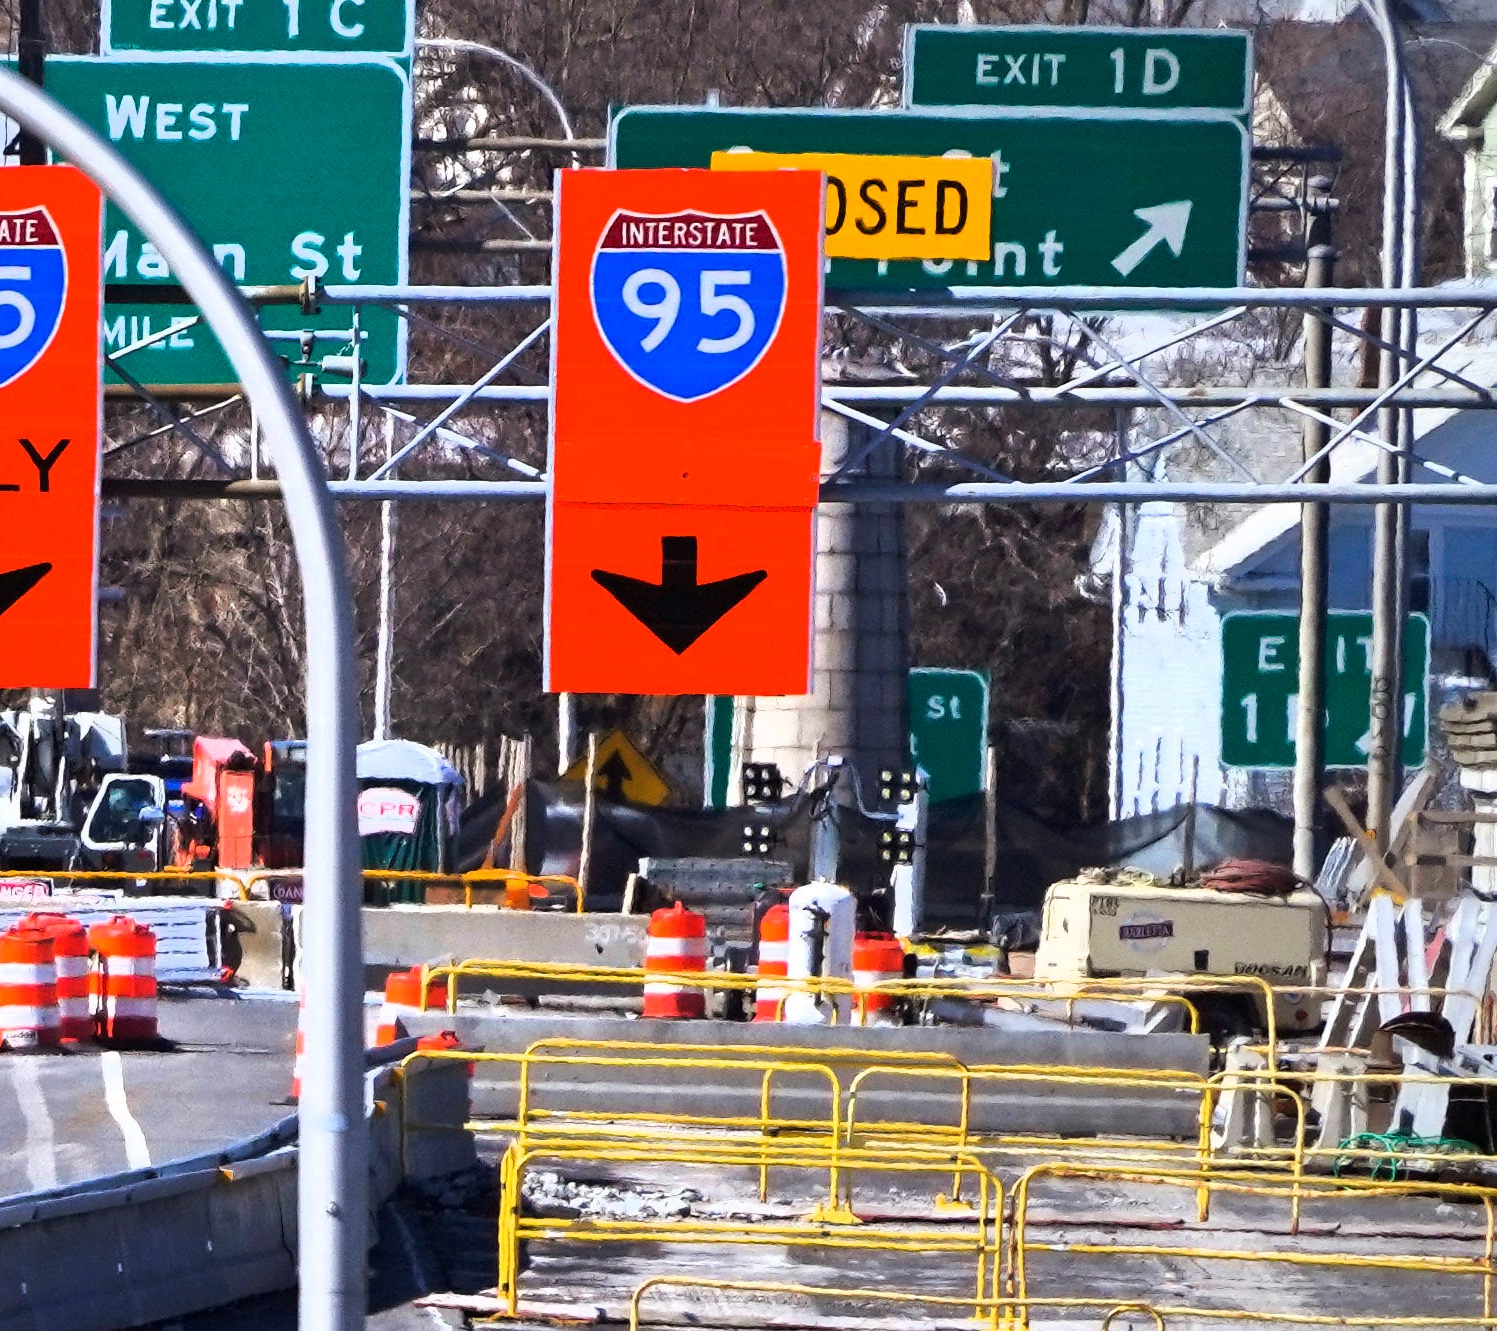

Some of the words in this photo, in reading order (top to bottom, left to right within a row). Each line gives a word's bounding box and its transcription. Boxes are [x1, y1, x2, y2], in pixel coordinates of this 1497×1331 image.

[149, 0, 243, 30] EXIT
[975, 52, 1066, 86] EXIT
[106, 94, 249, 141] WEST
[825, 177, 969, 237] OSED
[621, 215, 759, 248] INTERSTATE
[289, 231, 363, 282] St
[621, 267, 756, 355] 95
[1258, 635, 1374, 674] EIT
